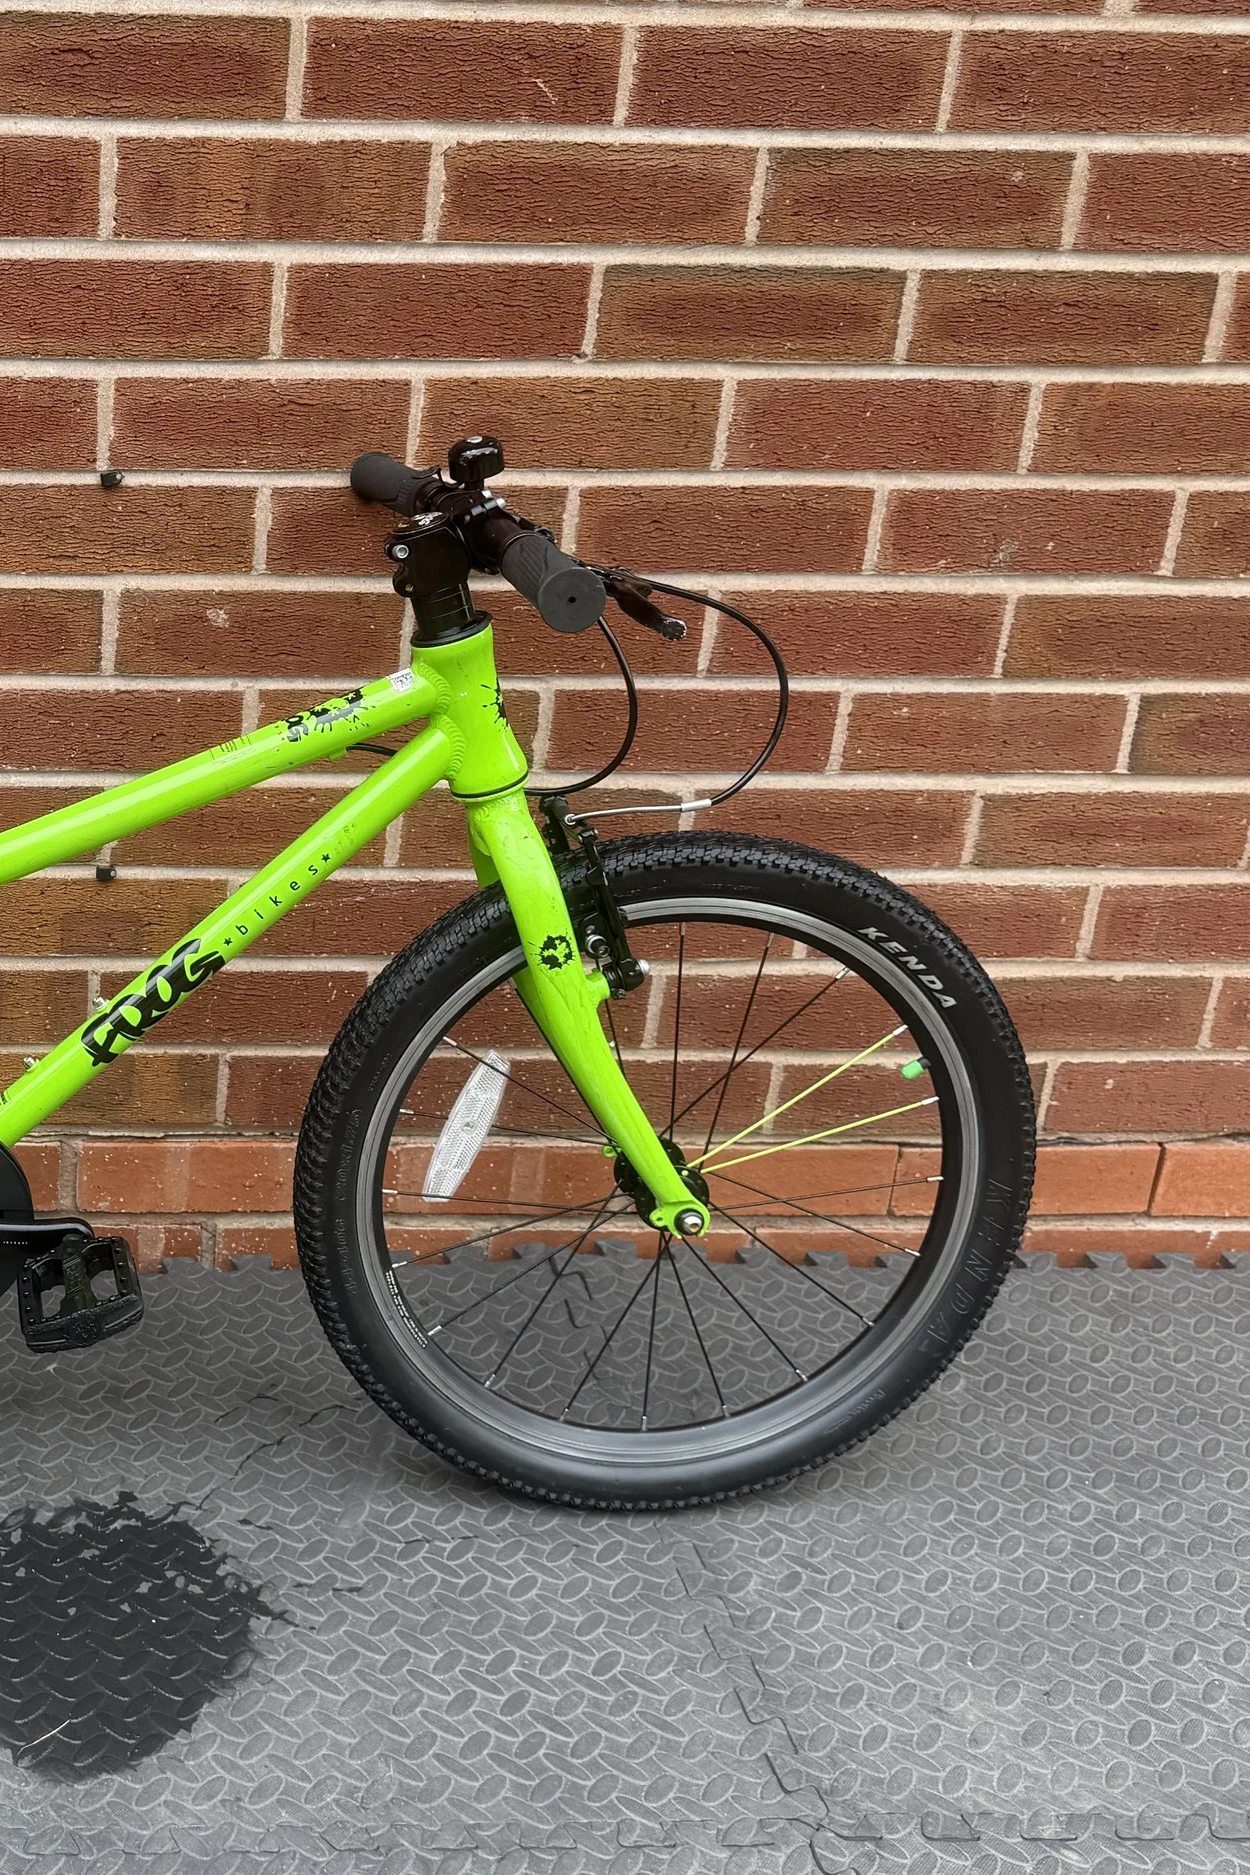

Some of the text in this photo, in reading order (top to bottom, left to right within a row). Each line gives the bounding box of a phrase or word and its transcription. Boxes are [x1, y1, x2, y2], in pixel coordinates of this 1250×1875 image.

[80, 864, 320, 1067] FROG bikes
[857, 926, 958, 1010] KENDA
